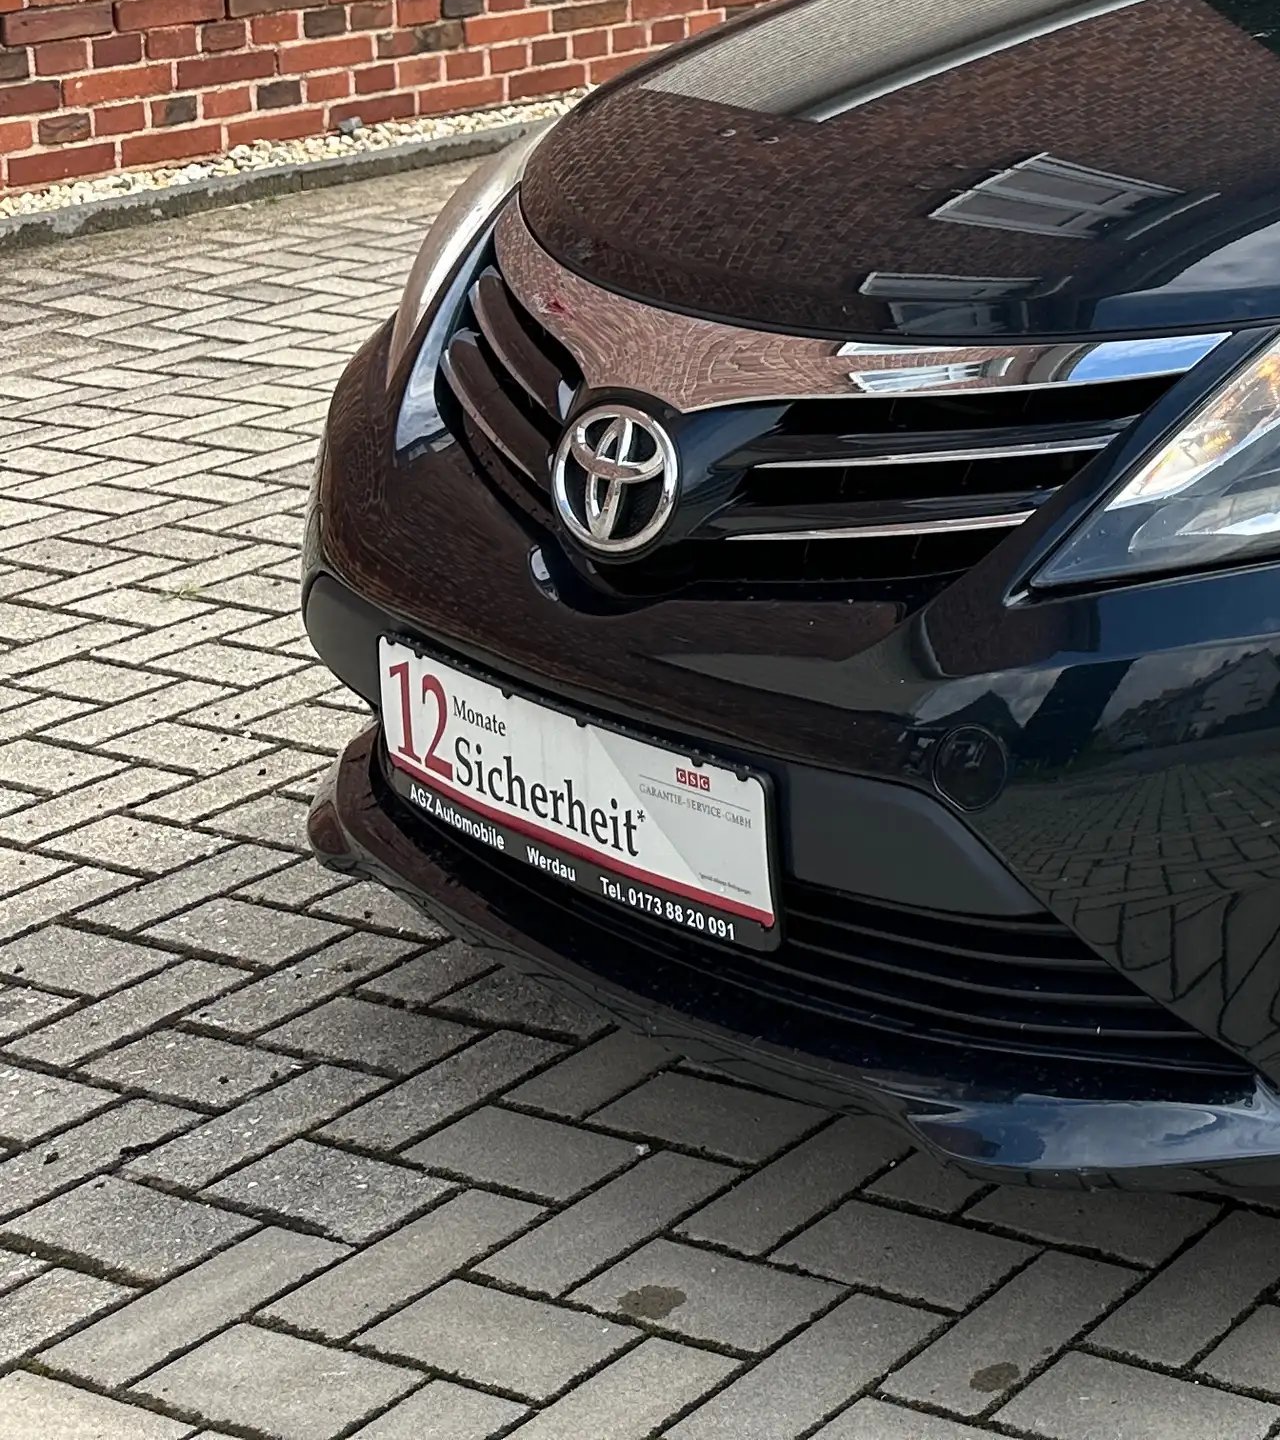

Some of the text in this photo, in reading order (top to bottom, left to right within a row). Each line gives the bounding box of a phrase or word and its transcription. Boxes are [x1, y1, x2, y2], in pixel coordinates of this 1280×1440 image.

[389, 661, 453, 782] 12
[451, 695, 507, 737] Monate
[677, 768, 709, 791] GSG
[409, 783, 735, 941] AGZ Automobile Werdau Tel. 0173 88 20 091
